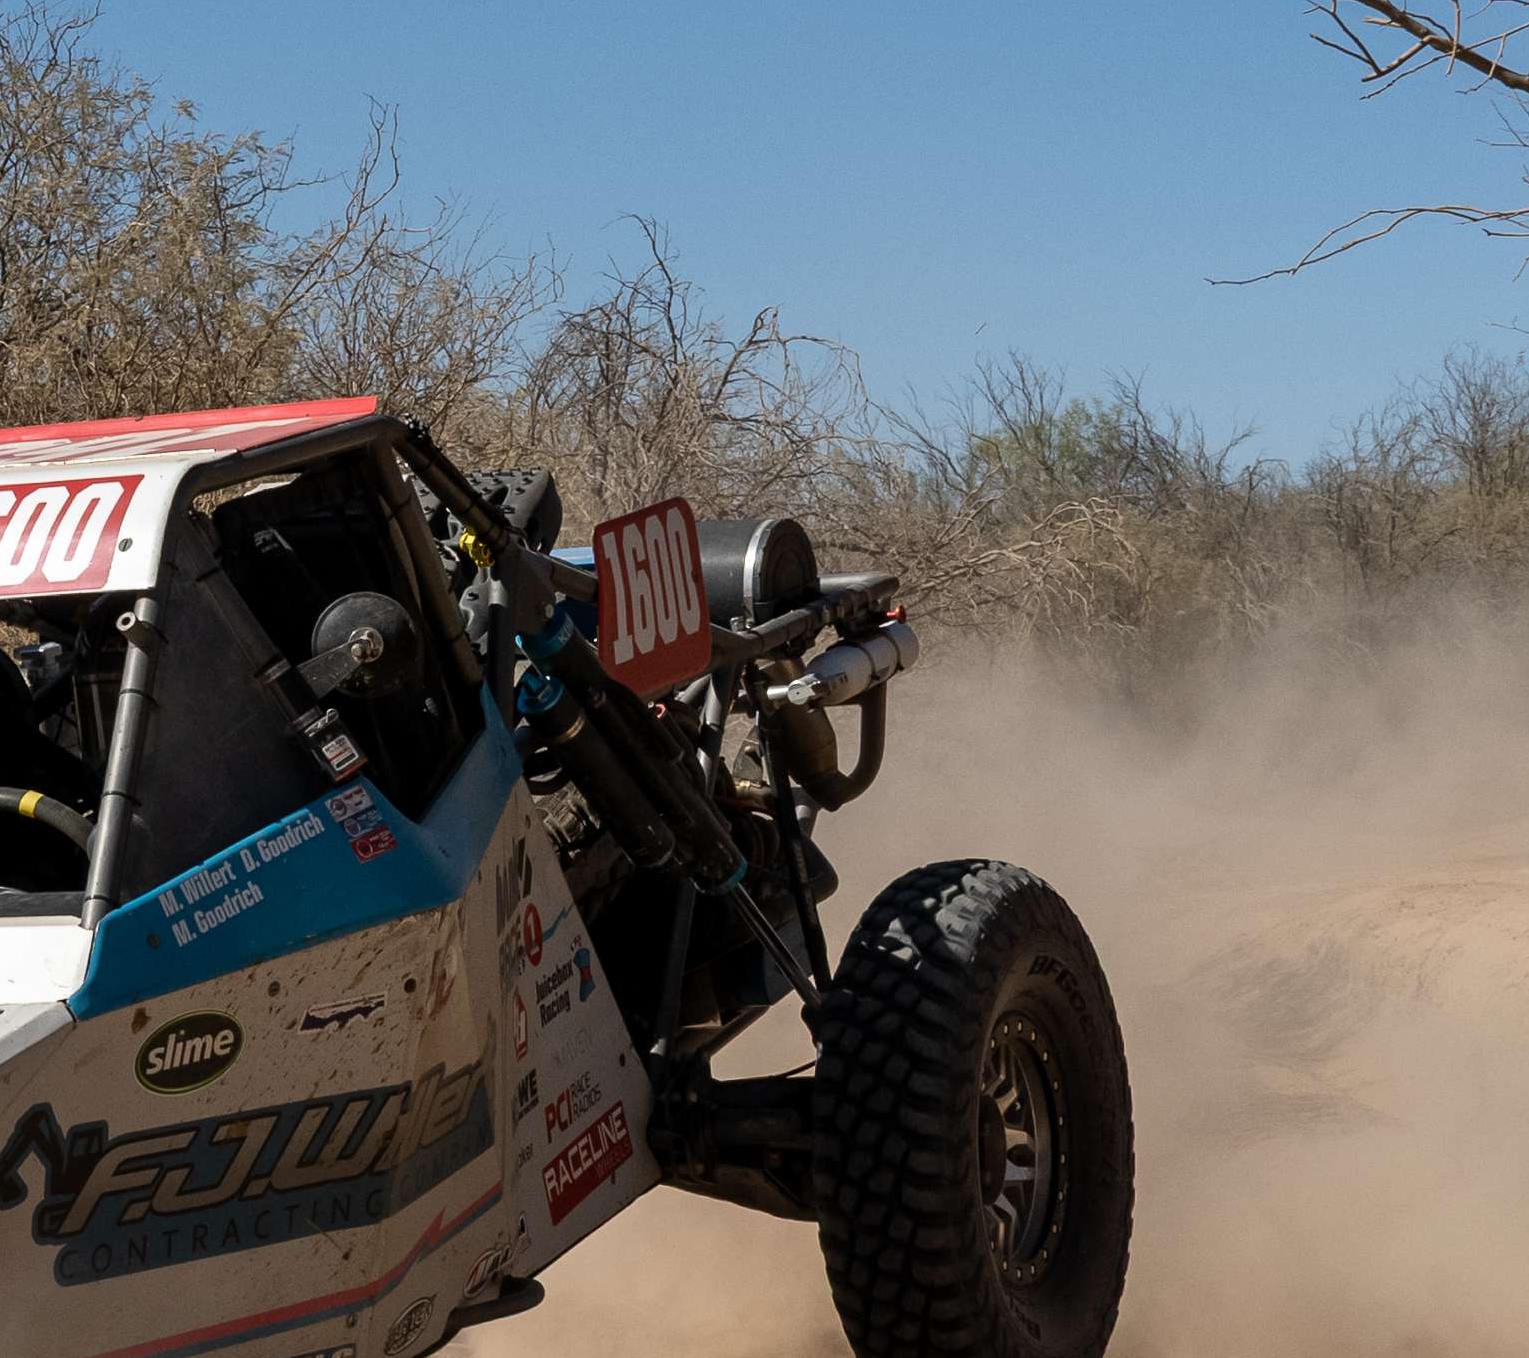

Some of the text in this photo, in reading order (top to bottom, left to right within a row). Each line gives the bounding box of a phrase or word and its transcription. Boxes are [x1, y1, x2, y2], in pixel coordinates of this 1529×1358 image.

[600, 506, 701, 665] 1600
[158, 889, 184, 918] M.
[179, 860, 237, 905] Willert
[239, 848, 261, 873] D.
[256, 812, 326, 863] Goodrich
[171, 880, 265, 948] M. Goodrich
[535, 959, 574, 1005] Juicebox
[540, 989, 572, 1028] Racing
[145, 1028, 235, 1076] slime
[544, 1088, 573, 1143] PCI
[543, 1104, 628, 1202] RACELINE
[57, 1188, 385, 1281] CONTRACTING
